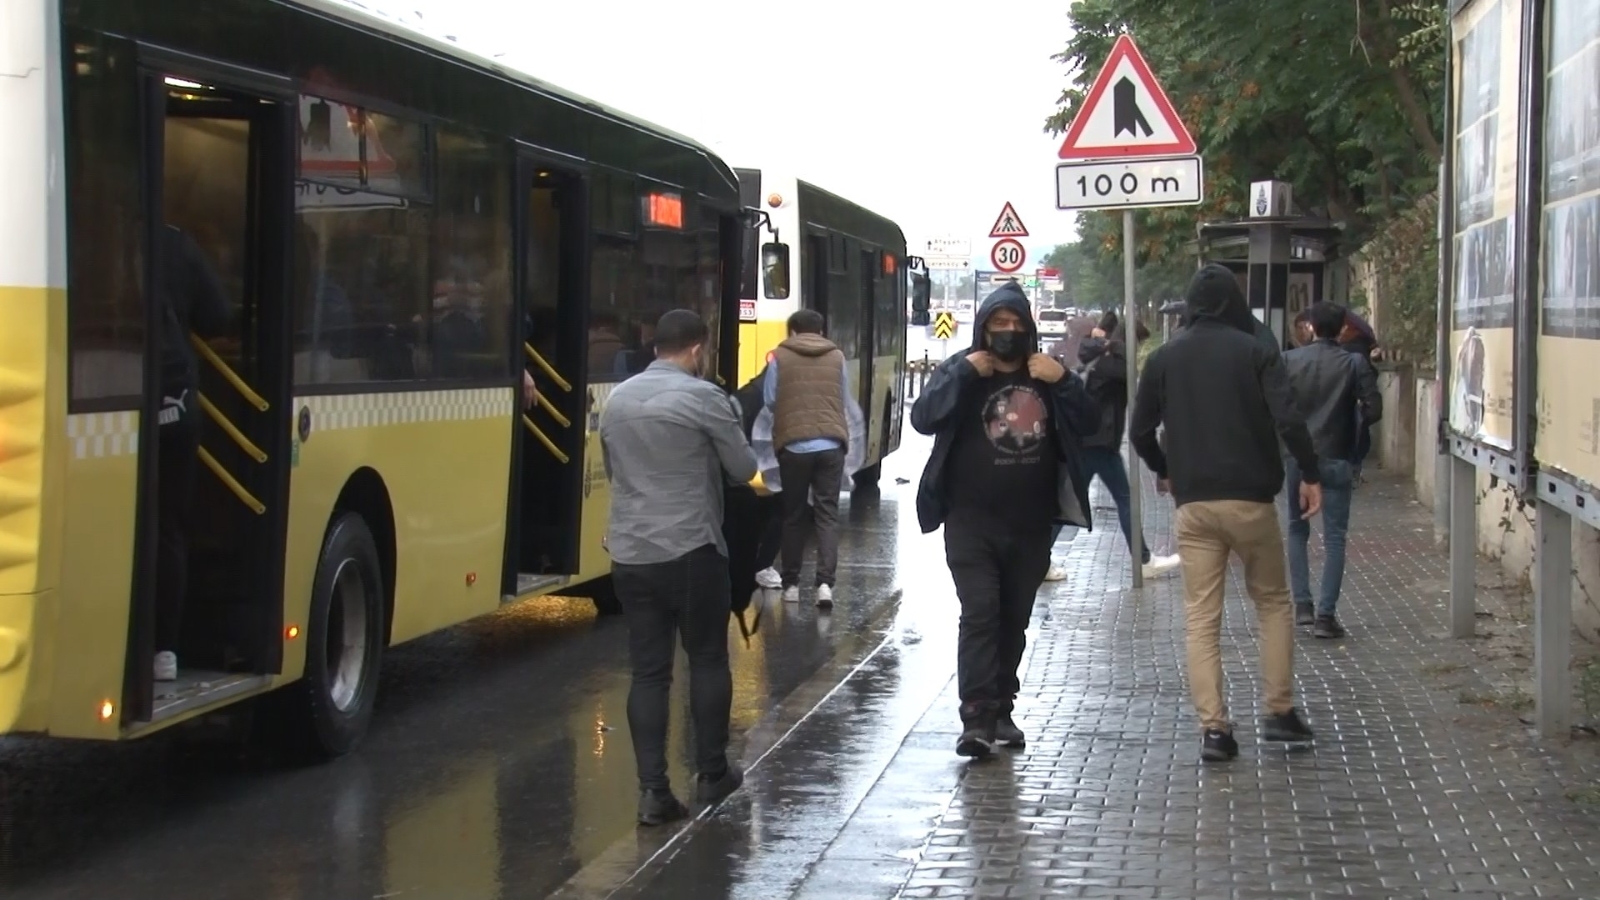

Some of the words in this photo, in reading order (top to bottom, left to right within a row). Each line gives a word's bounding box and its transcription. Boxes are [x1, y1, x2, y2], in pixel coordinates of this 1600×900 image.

[1077, 172, 1138, 197] 100
[1151, 176, 1179, 193] m
[999, 247, 1019, 264] 30
